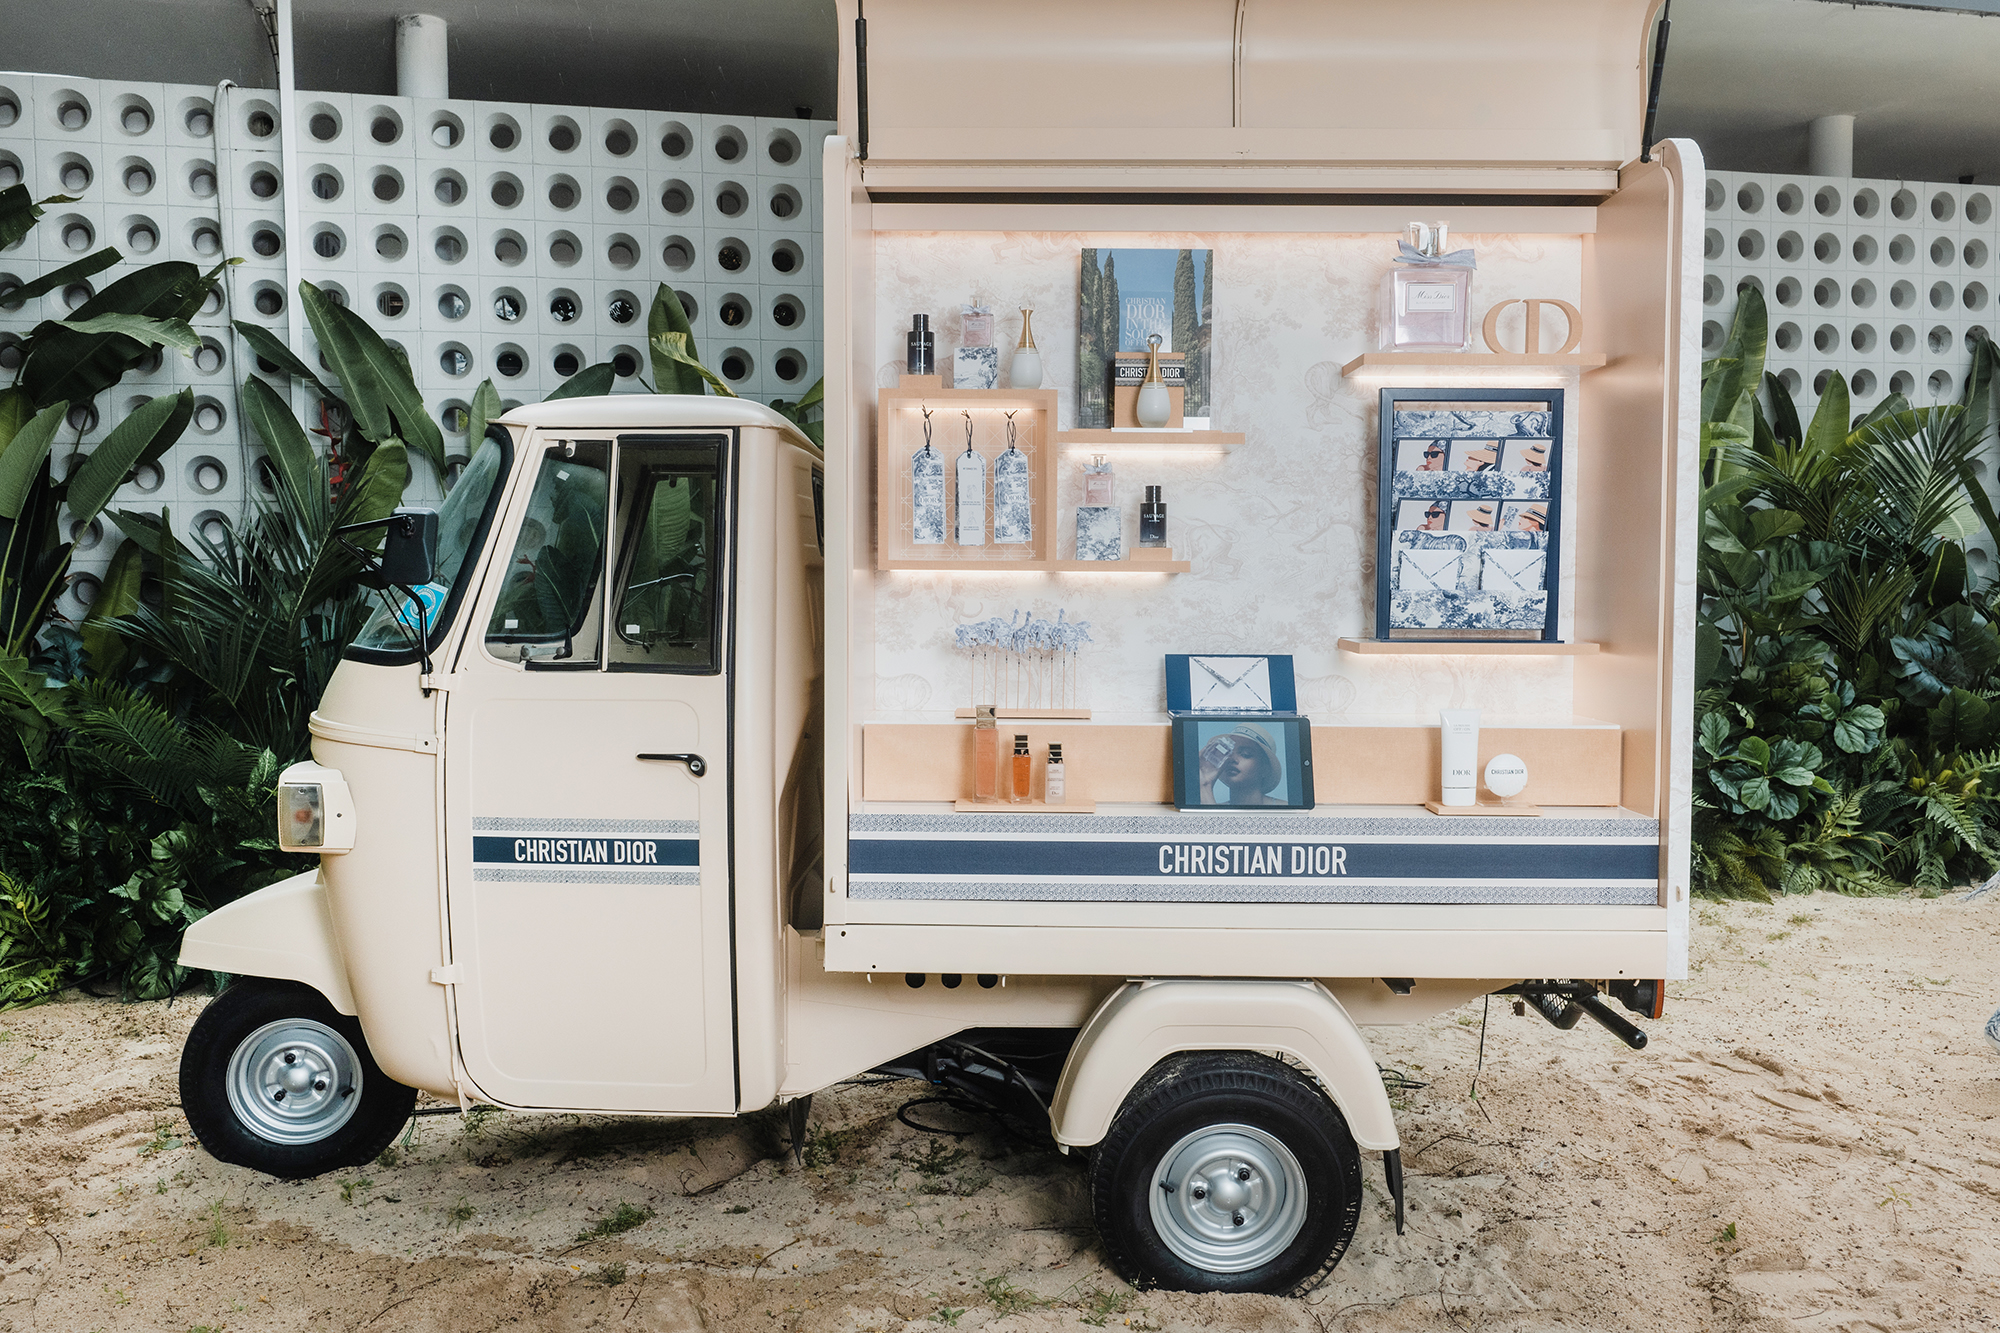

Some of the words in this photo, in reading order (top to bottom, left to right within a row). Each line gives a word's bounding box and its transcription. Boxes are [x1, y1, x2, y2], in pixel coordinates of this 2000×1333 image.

[1127, 304, 1165, 319] DIOR
[1126, 319, 1140, 329] IN
[1120, 367, 1147, 378] CHRIST
[1162, 367, 1180, 378] DIOR
[514, 838, 608, 863] CHRISTIAN
[613, 840, 658, 864] DIOR
[1158, 844, 1283, 875] CHRISTIAN
[1290, 845, 1348, 875] DIOR
